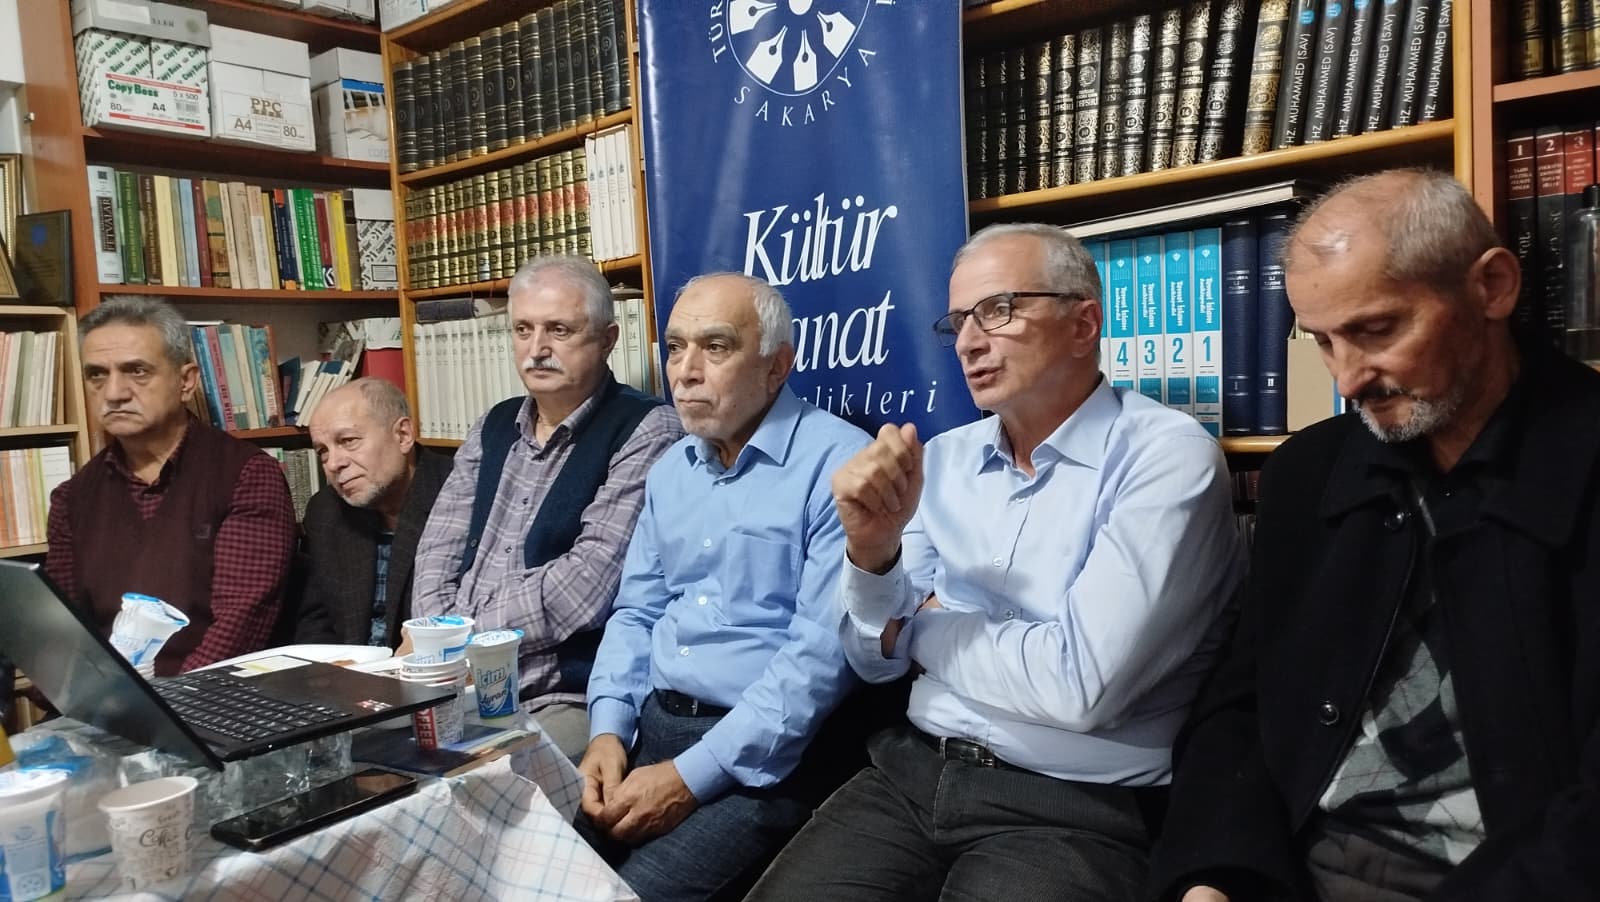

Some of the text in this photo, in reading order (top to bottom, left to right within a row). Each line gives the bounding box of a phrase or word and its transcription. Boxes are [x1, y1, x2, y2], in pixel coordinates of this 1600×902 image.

[708, 0, 727, 63] TÜR
[1297, 33, 1311, 60] (SAV)
[1424, 0, 1450, 118] HZ. MUHAMMED (SAV
[1338, 18, 1365, 132] HZ. MUHAMMED (SAV)
[1368, 14, 1396, 129] HZ. MUHAMMED (SAV)
[1399, 6, 1428, 123] HZ. MUHAMMED (SAV)
[108, 80, 158, 97] Copy Boss
[734, 47, 876, 126] SAKARYA
[1289, 63, 1305, 124] MUHAMMED
[1311, 27, 1338, 138] HZ. MUHAMMED (SAV)
[110, 102, 122, 111] 80
[152, 102, 166, 112] A4
[250, 98, 282, 114] PPC
[234, 118, 252, 131] A4
[283, 126, 297, 138] 80
[1286, 127, 1297, 144] HZ.
[1517, 144, 1523, 156] 1
[1546, 140, 1555, 152] 2
[1574, 136, 1584, 147] 3
[102, 199, 114, 250] FETVALAR
[743, 192, 898, 286] Kültür
[791, 290, 895, 373] anat
[1116, 342, 1128, 366] 4
[1144, 340, 1156, 364] 3
[1172, 338, 1184, 362] 2
[1202, 336, 1210, 362] 1
[797, 380, 937, 416] likleri
[416, 708, 434, 746] FFEE
